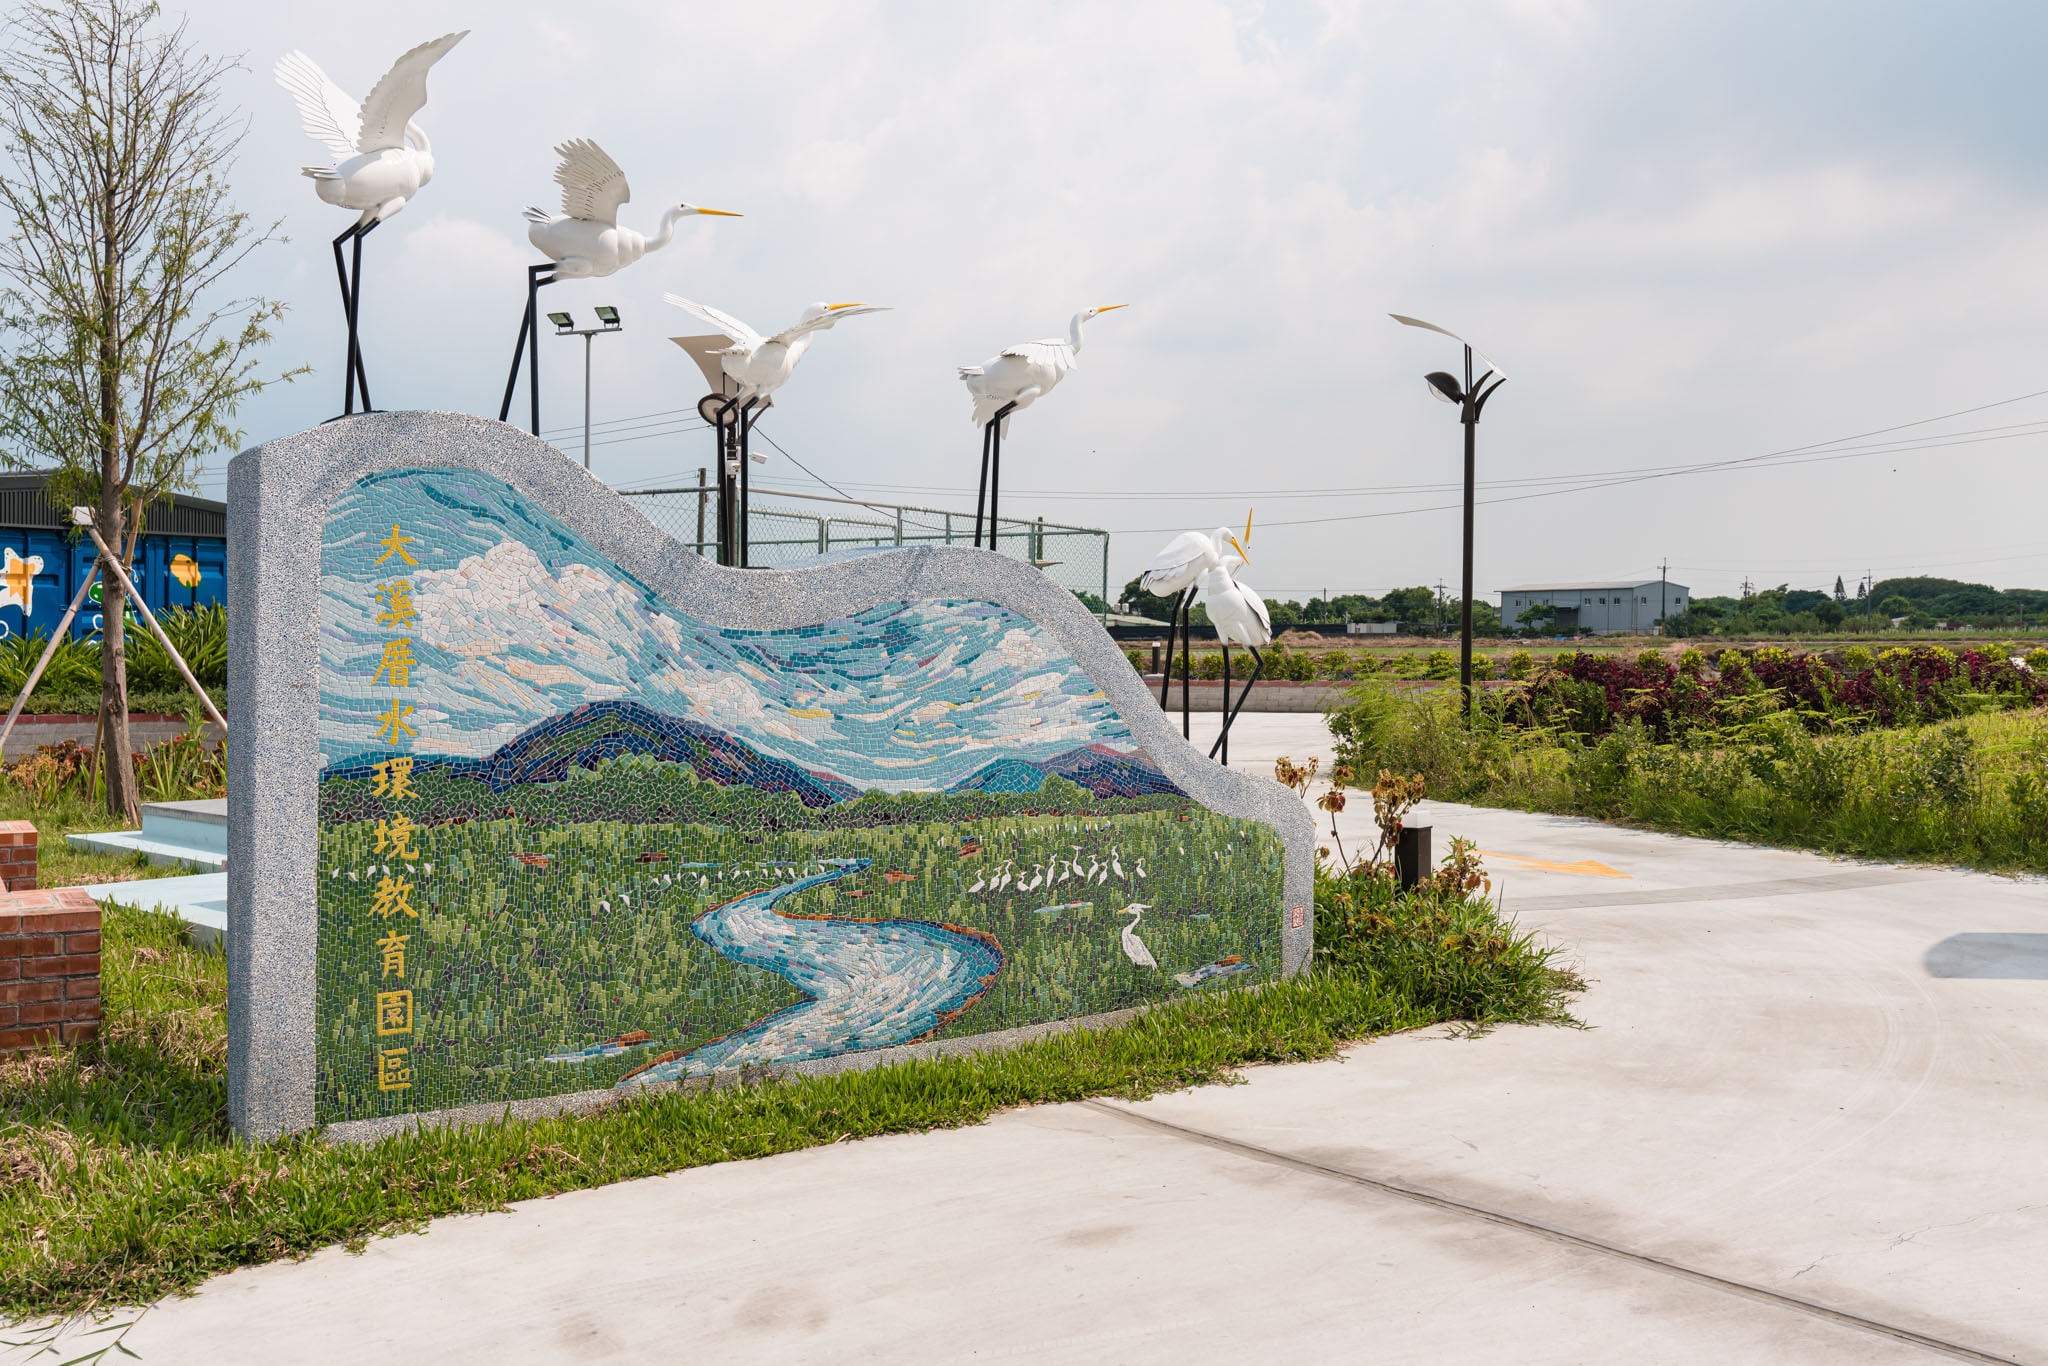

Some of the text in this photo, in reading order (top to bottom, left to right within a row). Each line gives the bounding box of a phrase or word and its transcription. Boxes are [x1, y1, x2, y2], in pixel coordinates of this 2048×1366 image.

[367, 524, 419, 1091] 大溪厝水環境教育園區
